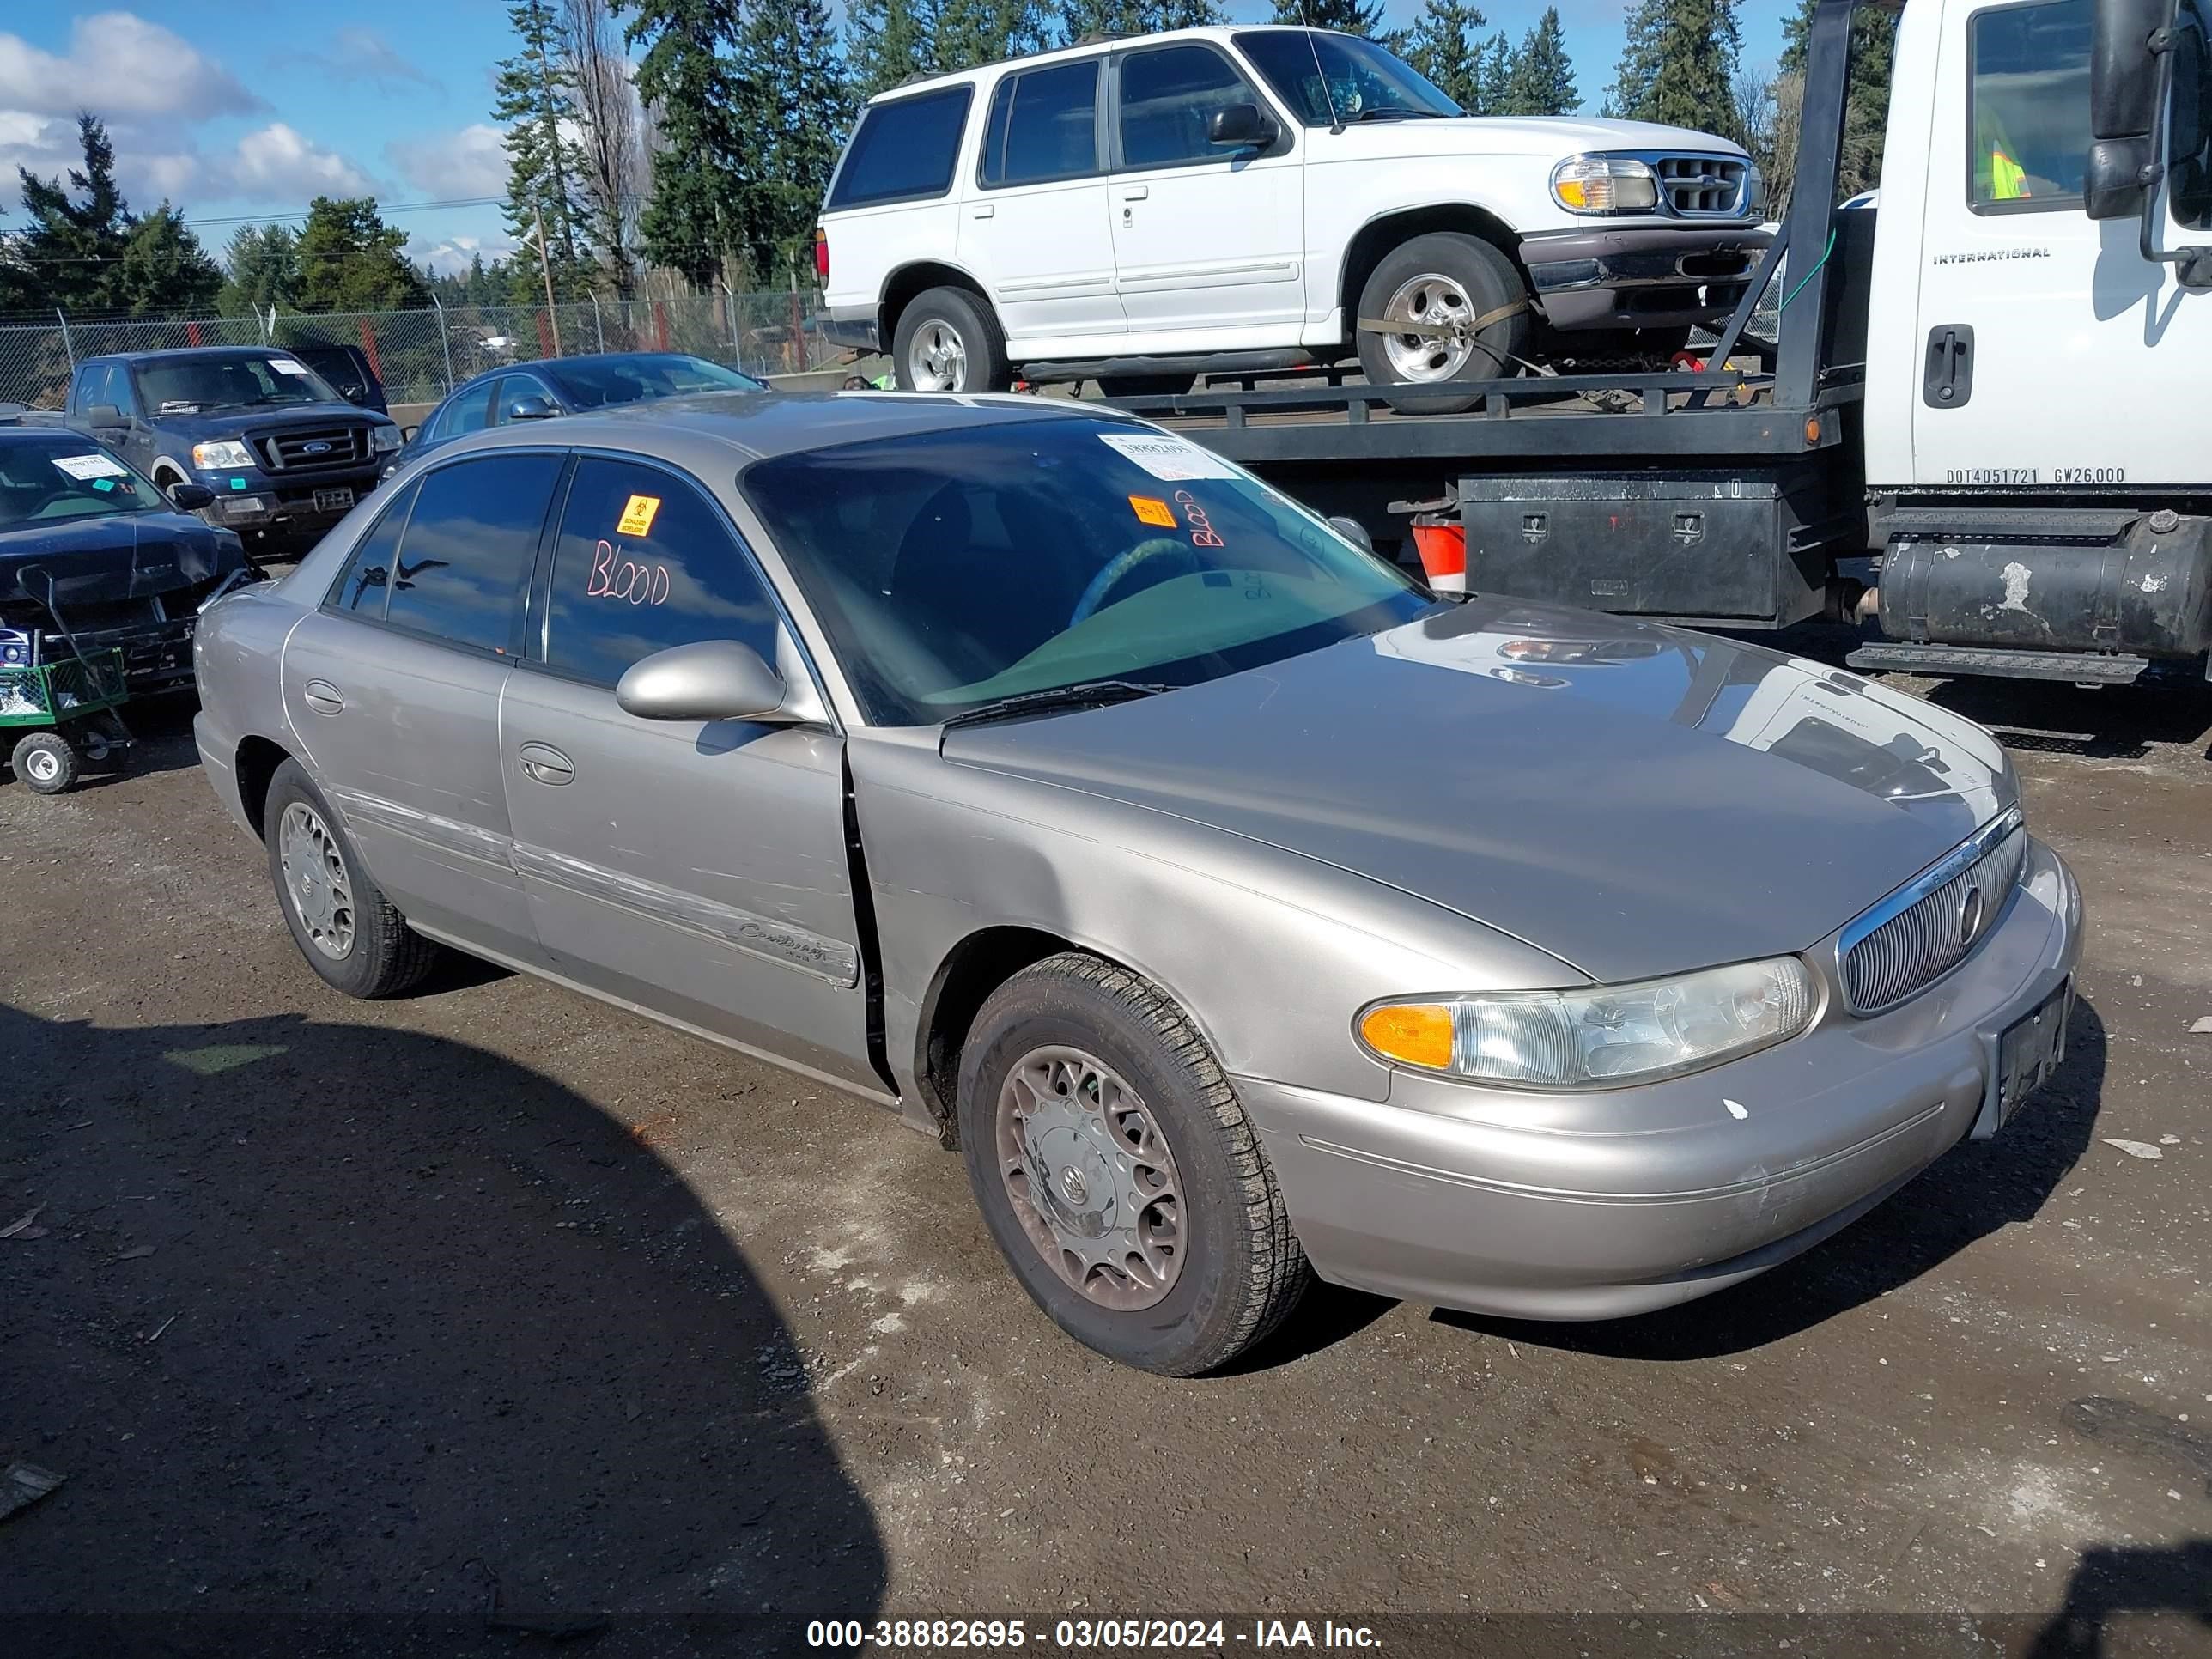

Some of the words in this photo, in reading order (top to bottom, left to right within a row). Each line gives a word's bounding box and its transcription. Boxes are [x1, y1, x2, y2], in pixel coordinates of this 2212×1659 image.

[1933, 247, 2051, 265] INTERNATIONAL
[1946, 469, 2038, 483] DOT4051721
[2054, 468, 2124, 484] GW26,000
[1174, 489, 1224, 547] BLOOD
[587, 539, 670, 605] BLOOD
